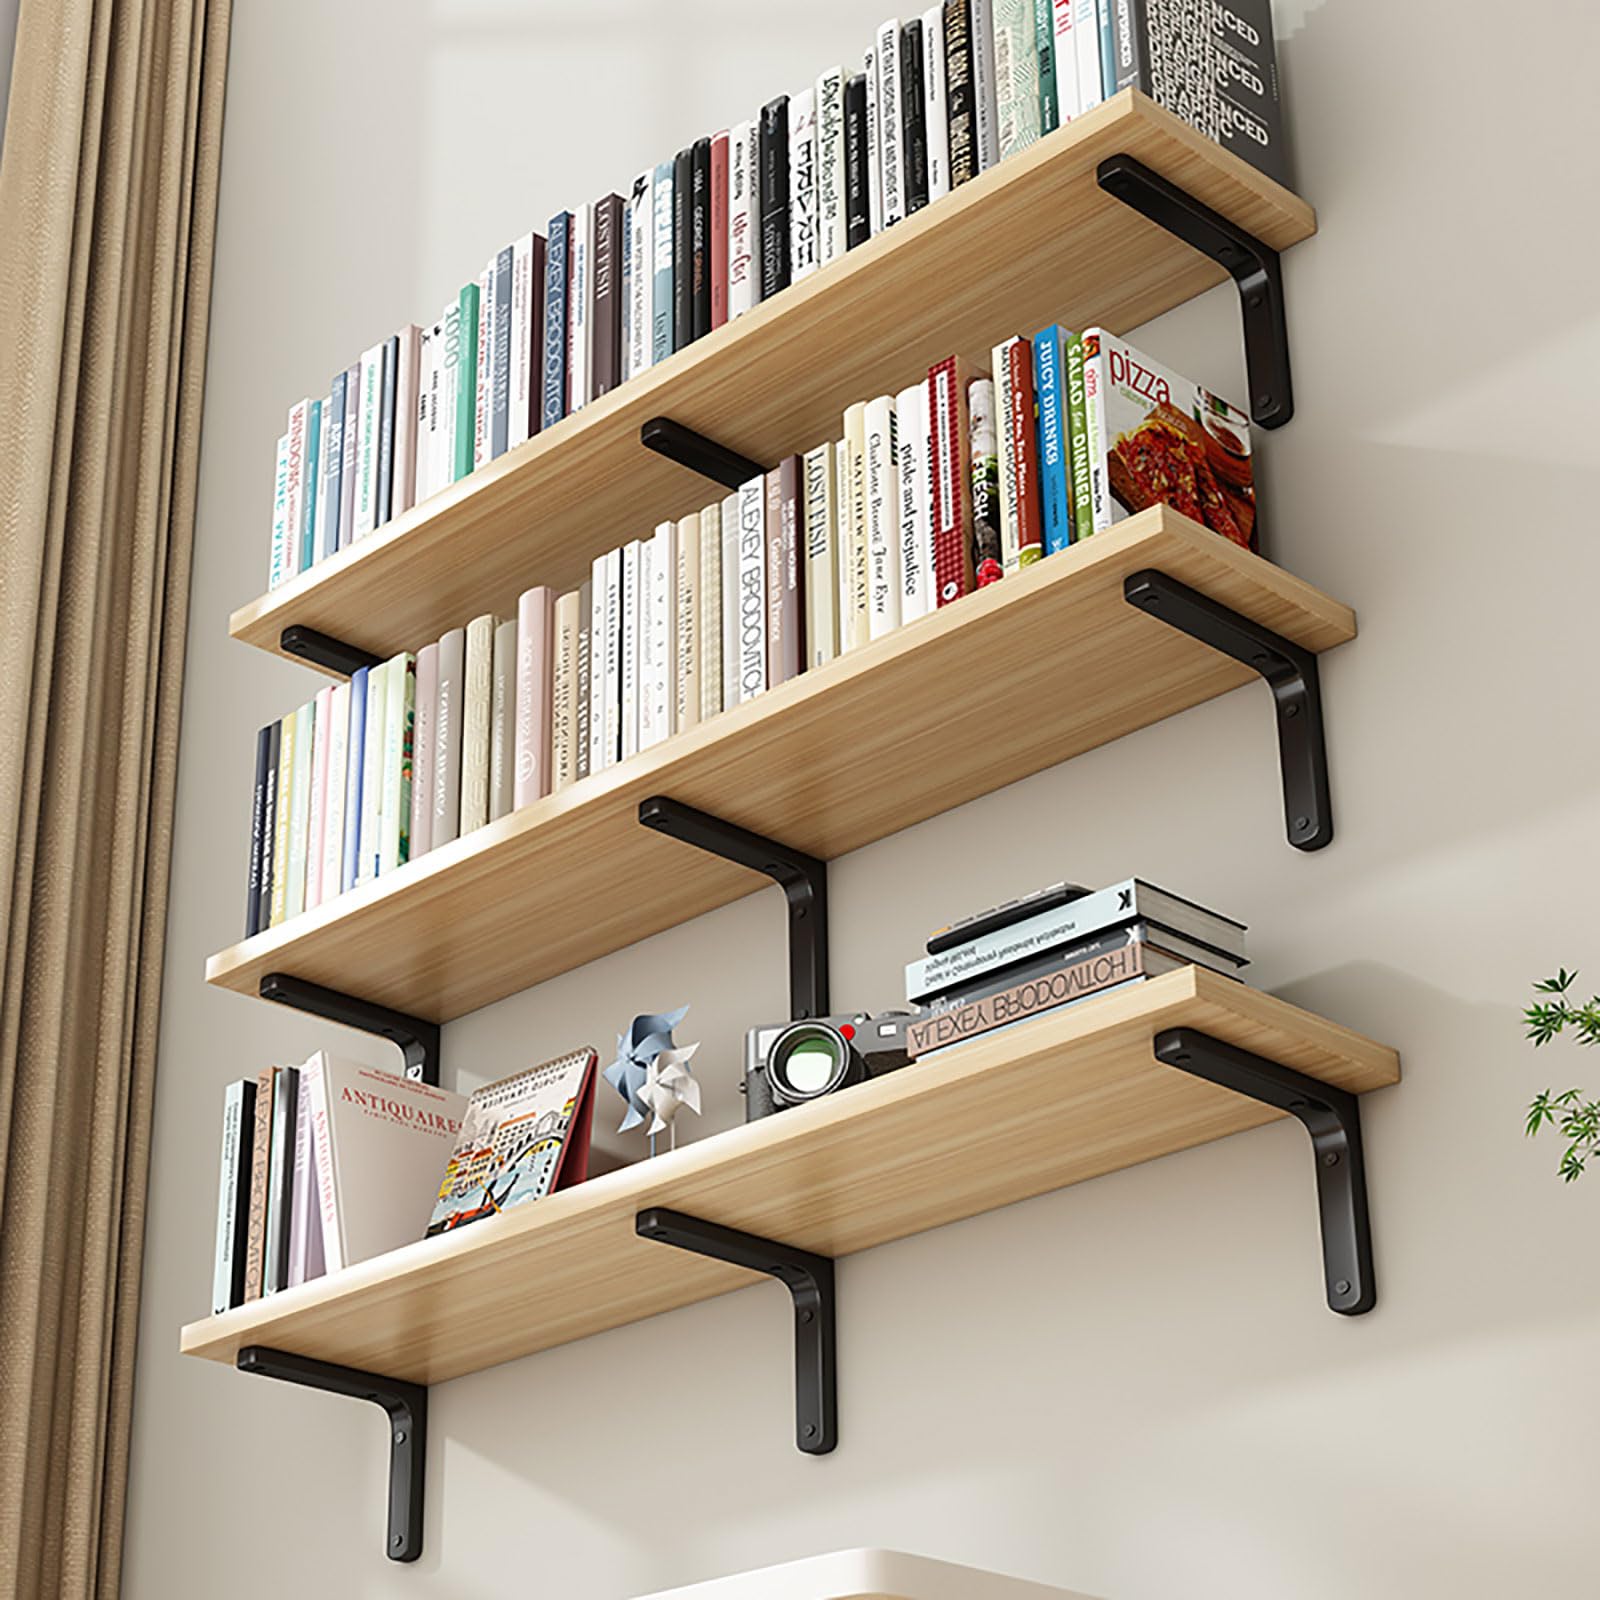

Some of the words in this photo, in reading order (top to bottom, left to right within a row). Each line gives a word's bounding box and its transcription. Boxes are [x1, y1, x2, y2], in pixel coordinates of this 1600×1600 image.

[1146, 4, 1264, 96] REFERENCED
[1148, 21, 1229, 87] GRAPHIC
[1202, 0, 1260, 46] ENCED
[1150, 54, 1269, 146] REFERENCED
[1152, 72, 1233, 138] GRAPHIC
[1109, 347, 1171, 408] pizza
[742, 484, 763, 560] ALEXEY
[742, 565, 763, 699] BRODOVITCH
[254, 1075, 272, 1155] ALEXEY
[314, 1110, 335, 1223] ANTIQUAIRES
